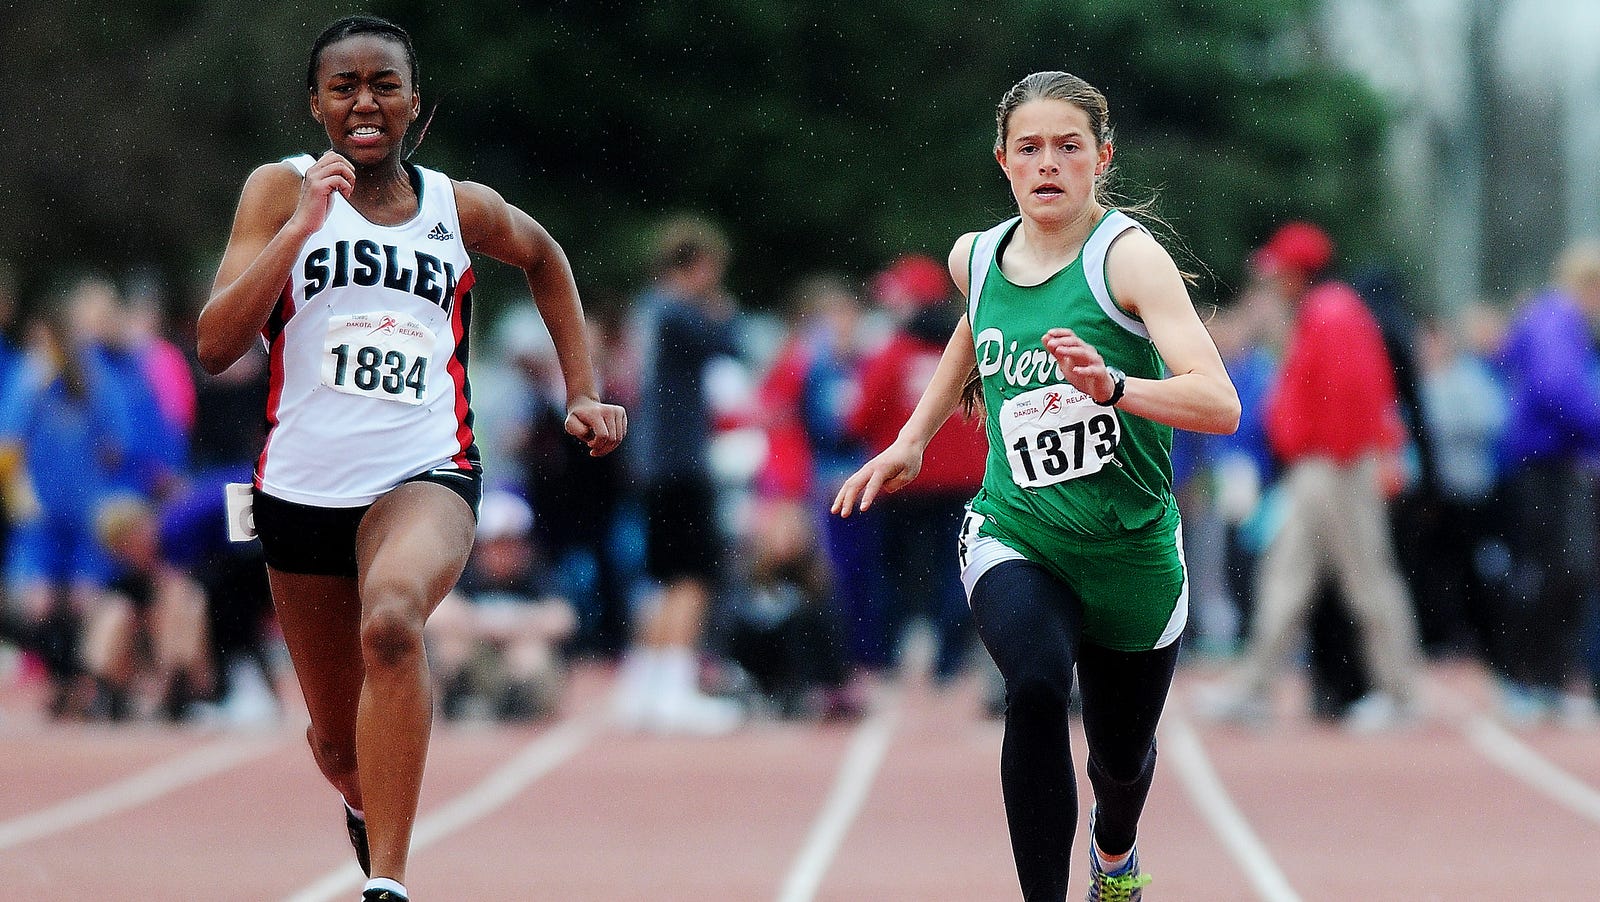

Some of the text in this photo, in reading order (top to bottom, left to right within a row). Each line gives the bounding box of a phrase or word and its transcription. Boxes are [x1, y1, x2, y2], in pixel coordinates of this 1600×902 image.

[399, 328, 424, 338] RELAYS
[976, 328, 1065, 387] Pierr
[331, 344, 428, 399] 1834
[1013, 393, 1092, 418] DAKOTA RELAY
[1013, 414, 1117, 482] 1373
